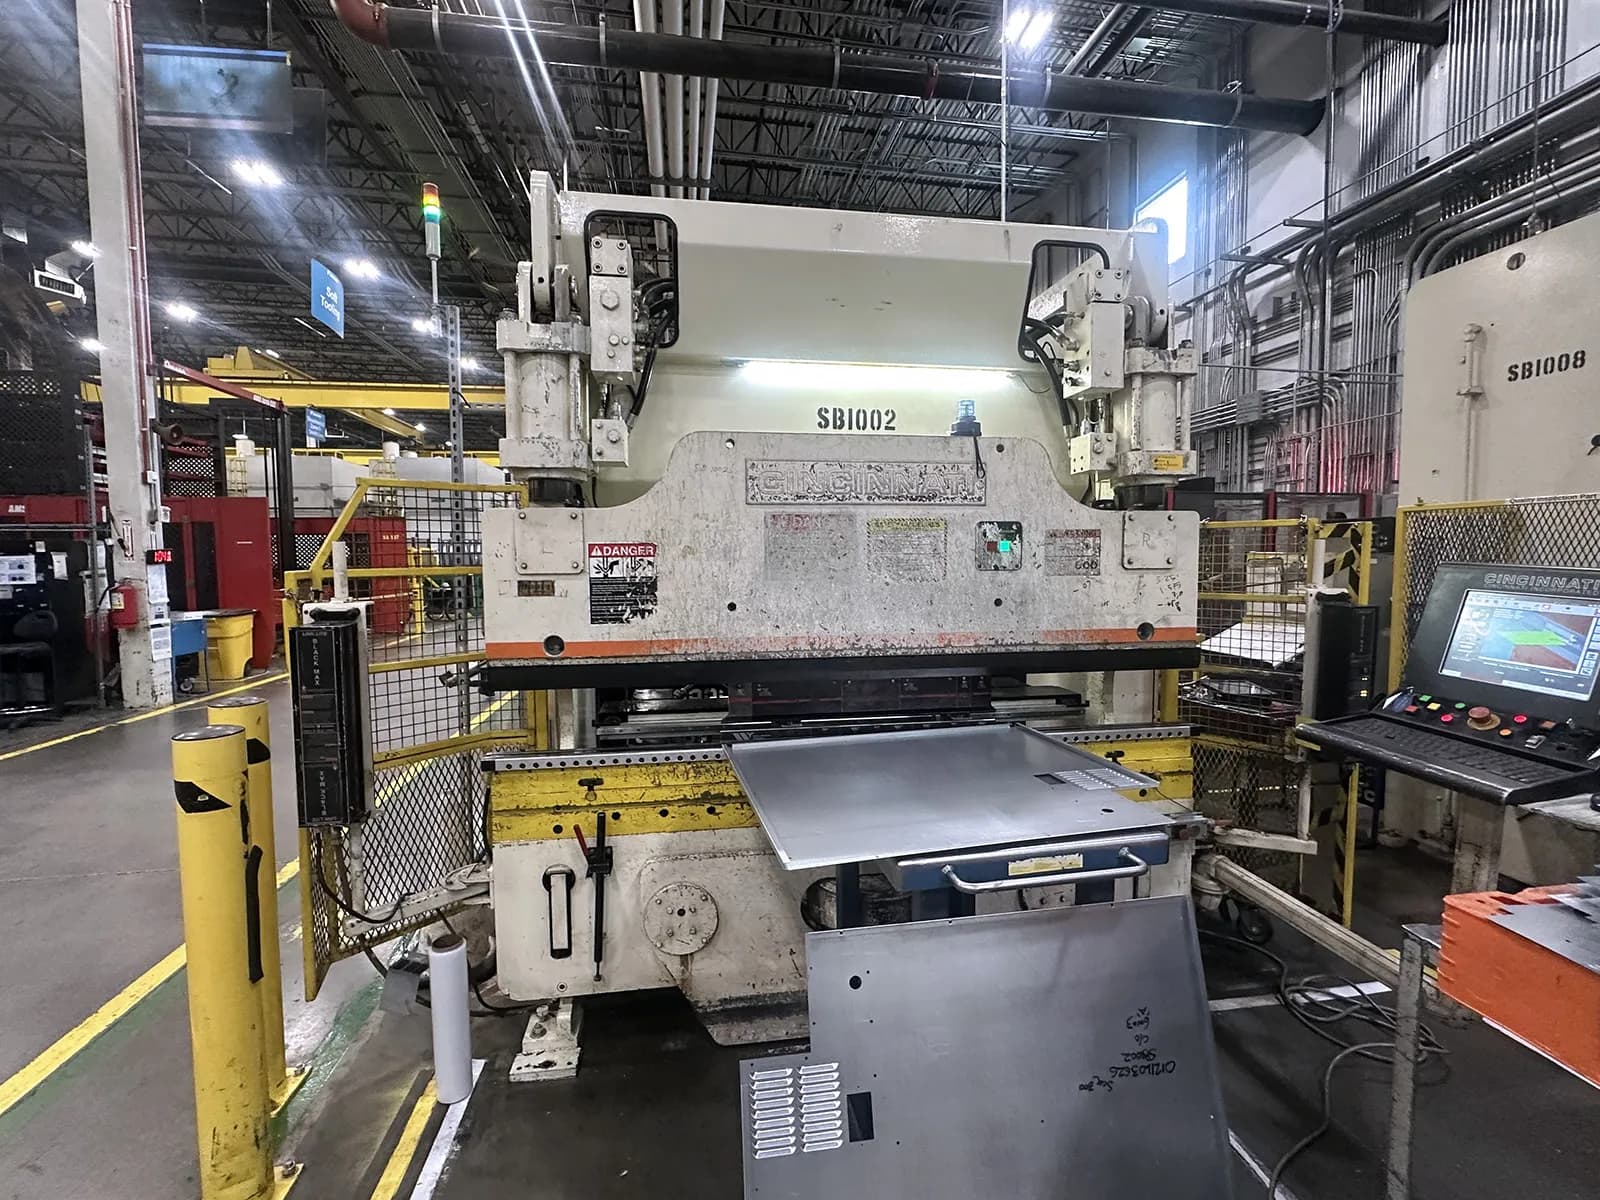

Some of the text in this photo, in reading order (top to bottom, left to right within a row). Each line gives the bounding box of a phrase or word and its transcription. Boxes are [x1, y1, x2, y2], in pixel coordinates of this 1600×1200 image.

[1507, 350, 1586, 382] SB1008
[817, 407, 896, 431] SB1002
[758, 469, 977, 497] CINCINNATI
[602, 545, 654, 556] DANGER
[1484, 573, 1600, 591] CINCINNATI
[313, 668, 321, 686] MAX
